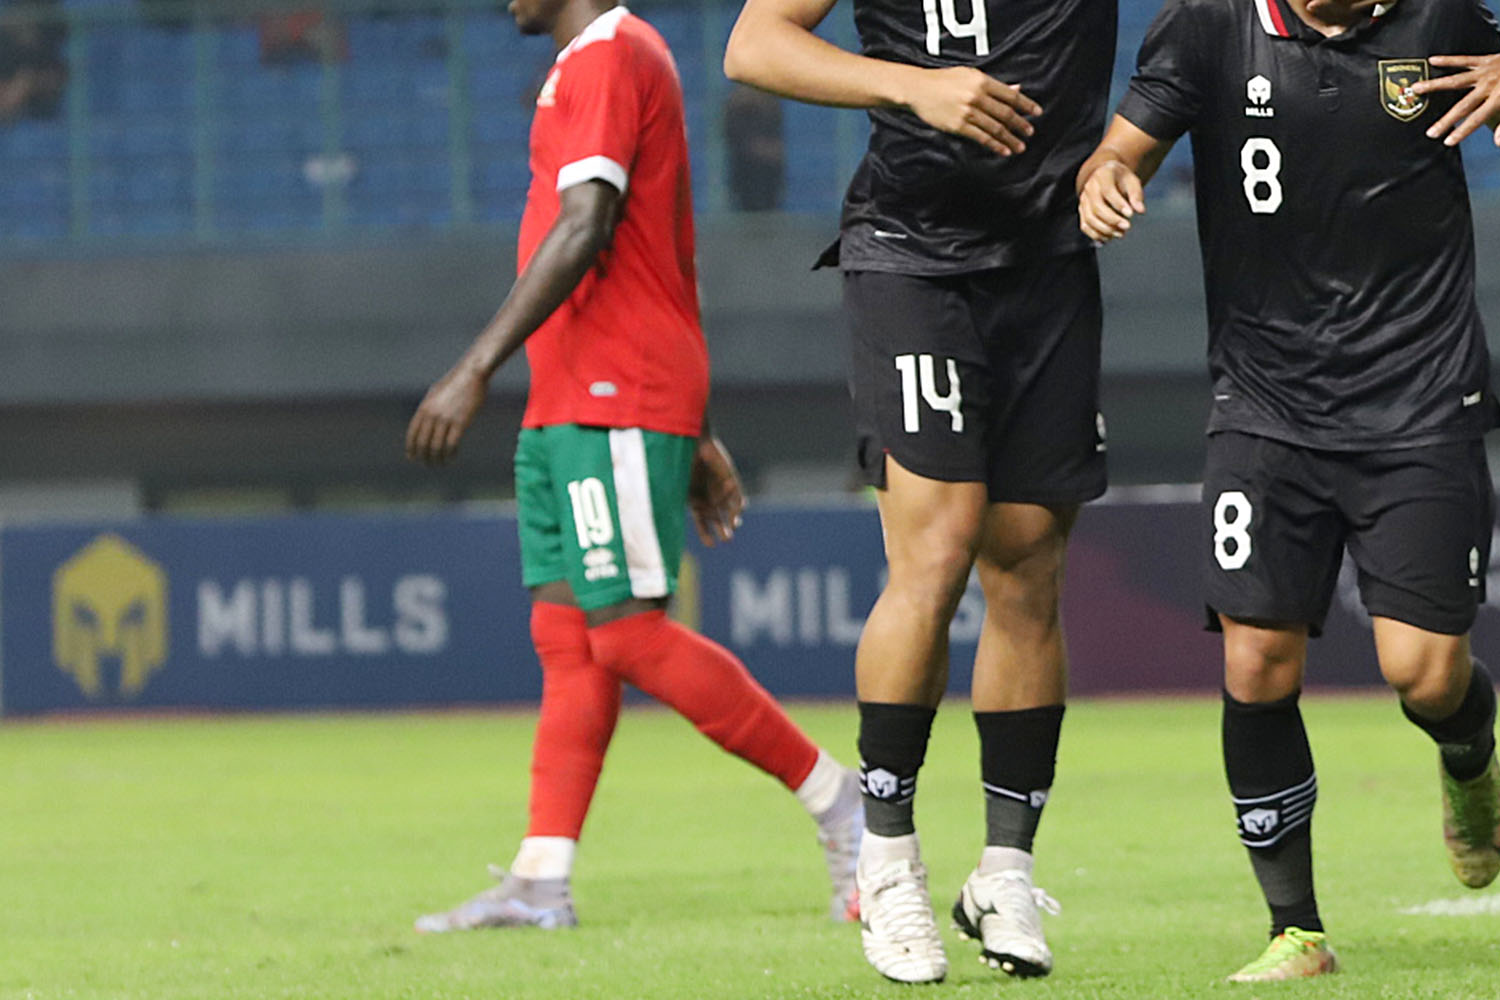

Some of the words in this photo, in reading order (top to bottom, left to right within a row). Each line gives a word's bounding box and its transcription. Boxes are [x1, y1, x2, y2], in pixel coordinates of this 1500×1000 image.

[1240, 137, 1283, 213] 8
[895, 353, 964, 433] 14
[567, 477, 614, 549] 19
[1213, 491, 1253, 570] 8
[199, 577, 448, 655] MILLS
